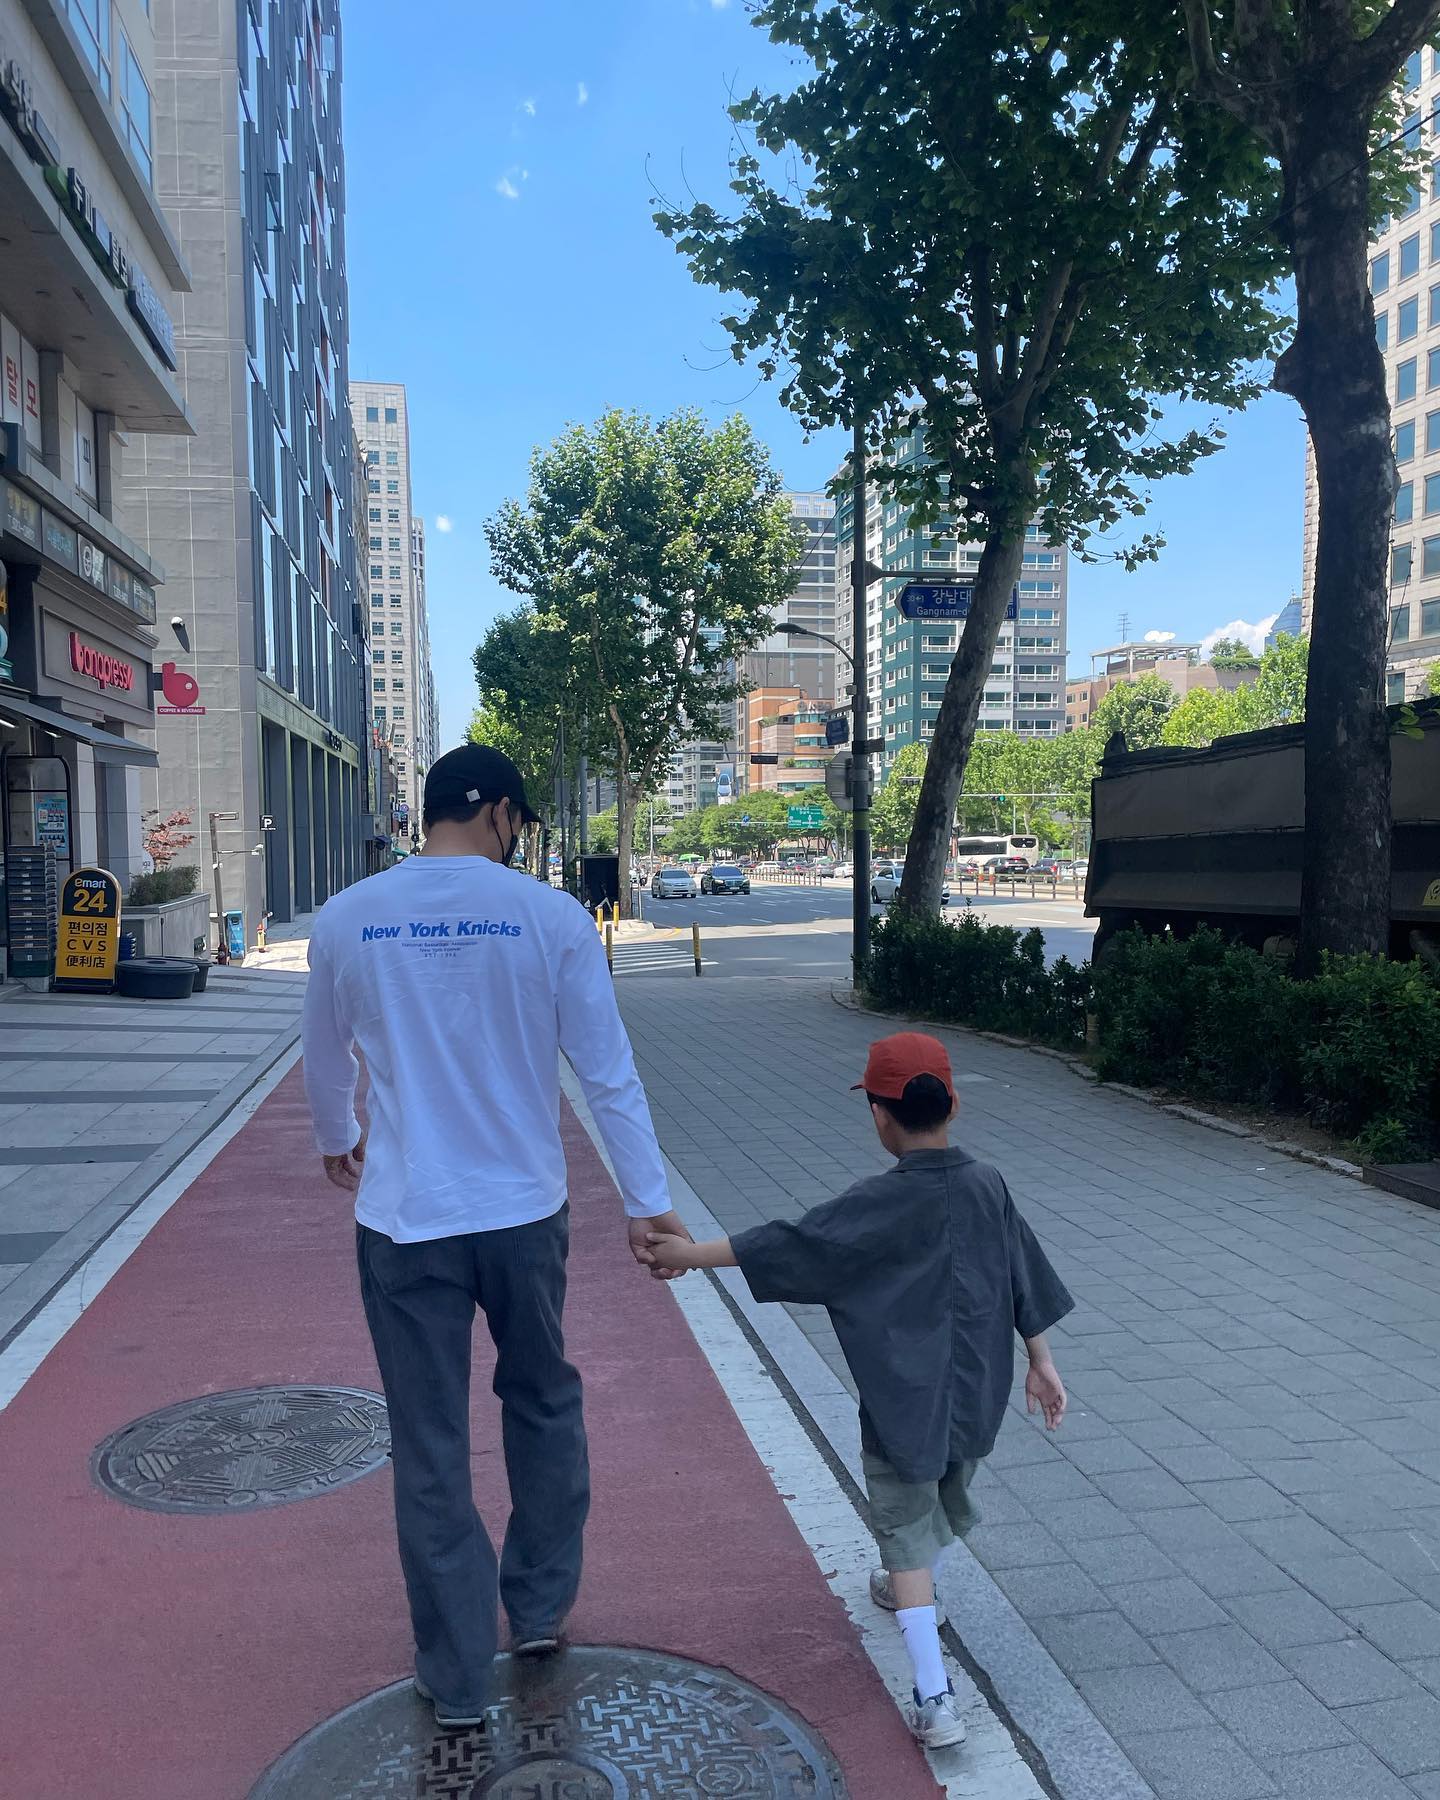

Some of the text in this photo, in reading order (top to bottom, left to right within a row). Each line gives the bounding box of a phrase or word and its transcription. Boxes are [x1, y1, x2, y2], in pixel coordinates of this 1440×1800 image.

[932, 589, 973, 605] 강남대
[916, 606, 969, 617] Gangnam-d
[264, 818, 272, 828] P
[75, 878, 106, 889] emart
[73, 889, 108, 913] 24
[68, 921, 107, 936] 편의점
[362, 919, 522, 942] New York Knicks
[66, 954, 106, 968] 便利店
